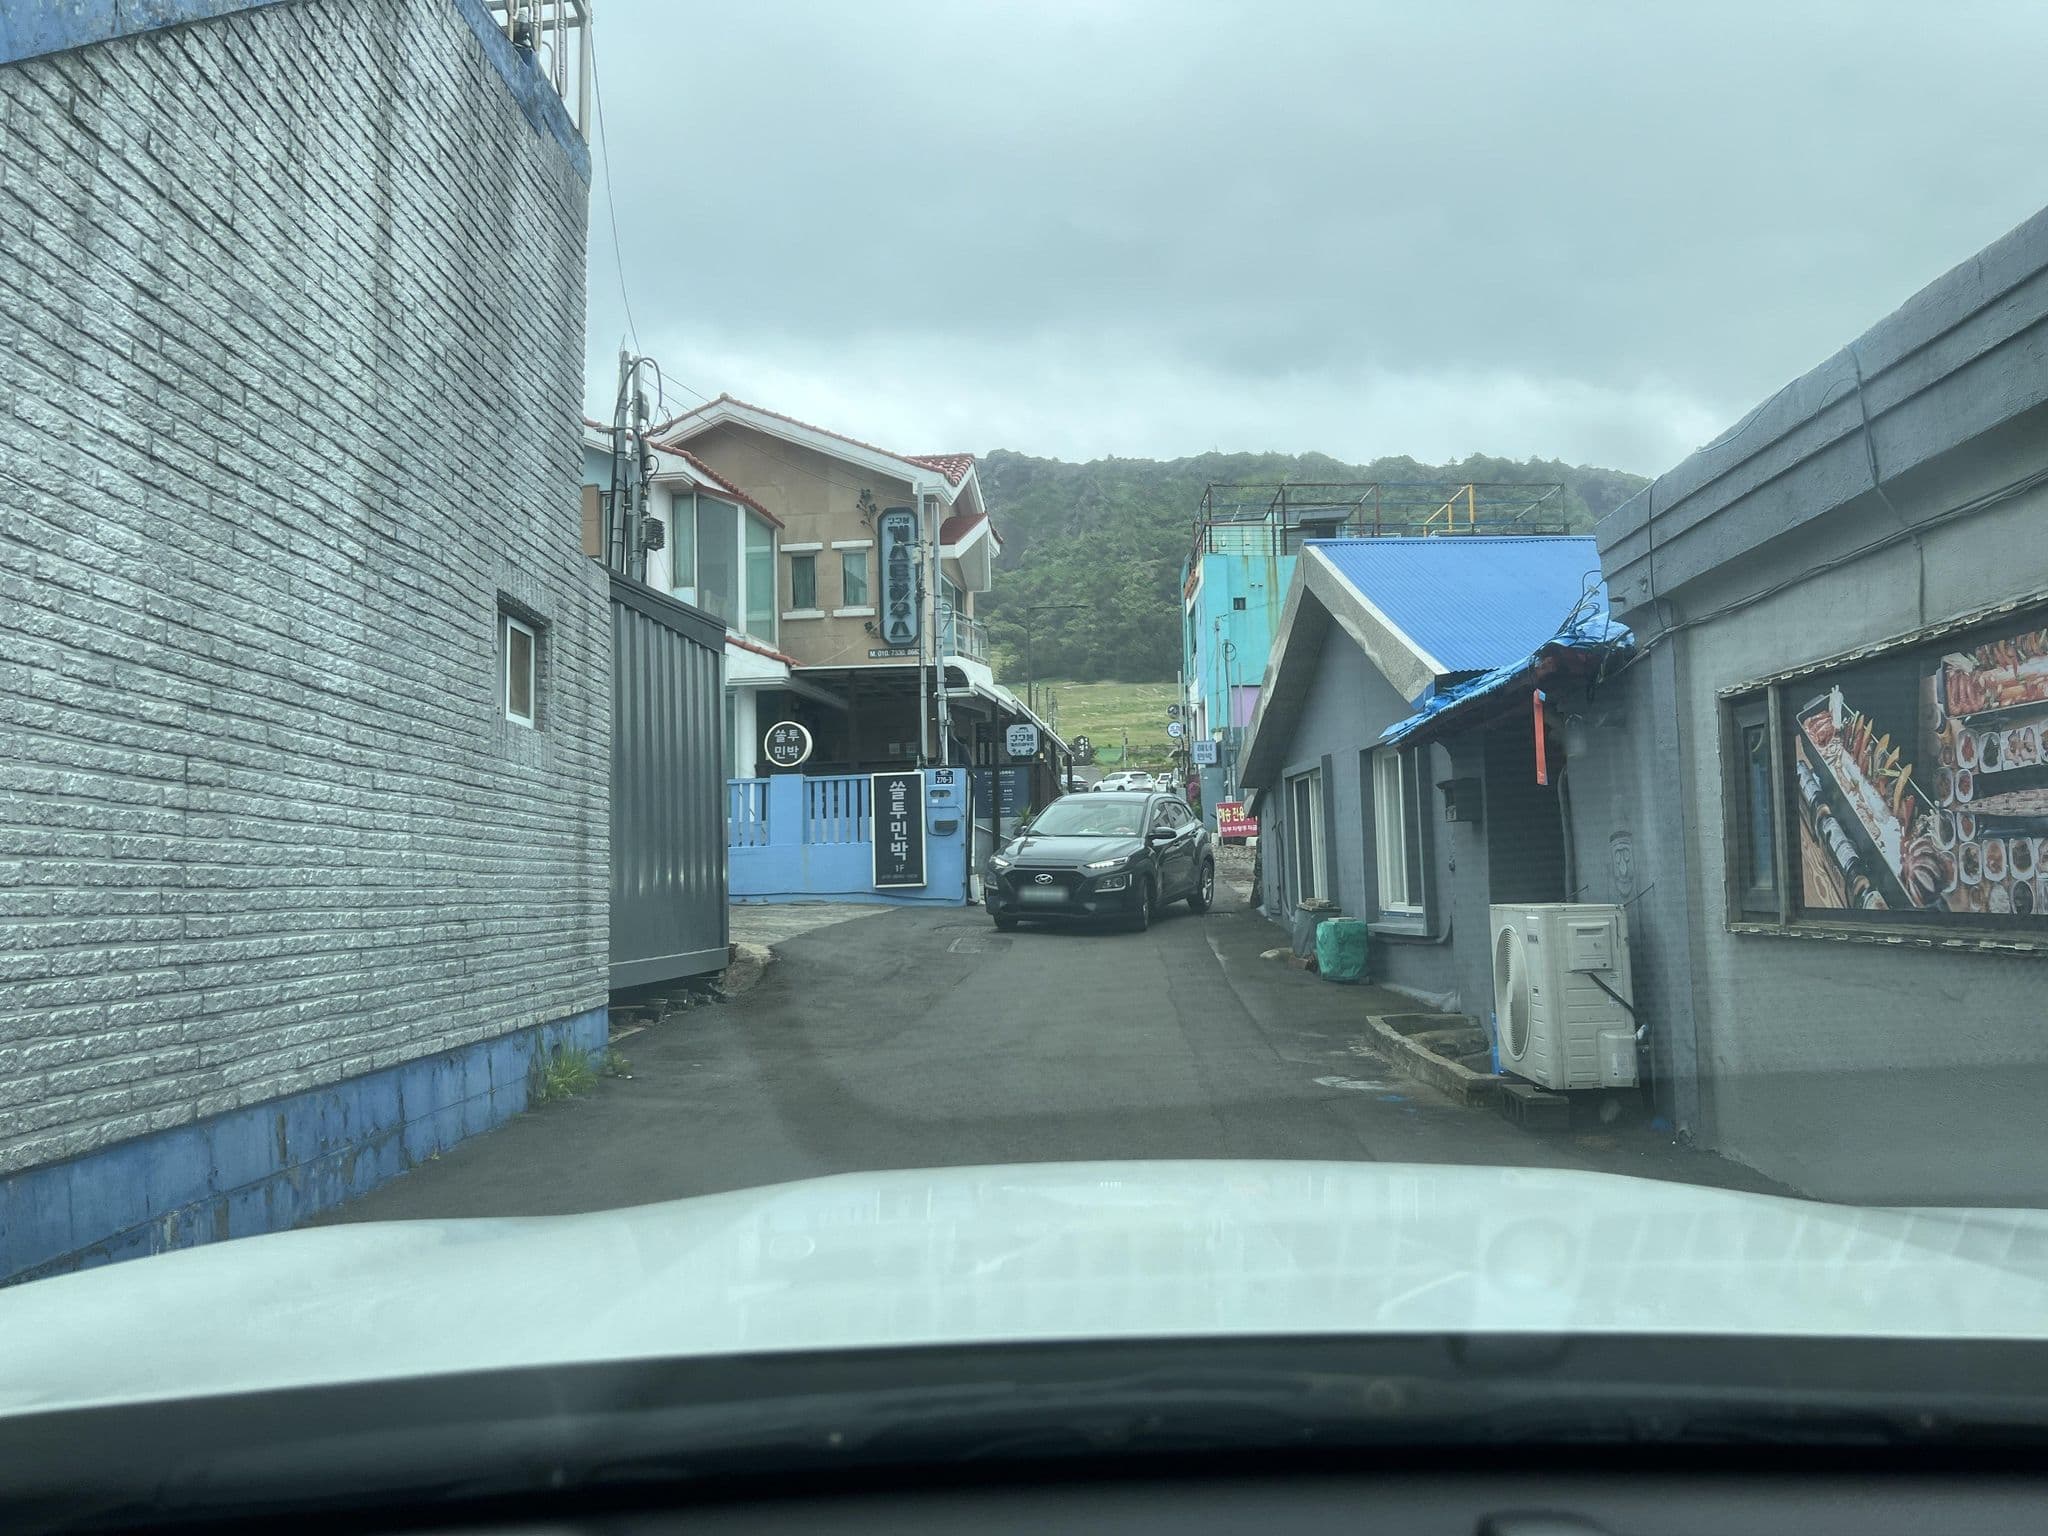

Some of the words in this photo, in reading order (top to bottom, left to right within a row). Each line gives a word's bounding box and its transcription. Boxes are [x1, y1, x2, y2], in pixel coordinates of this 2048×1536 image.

[775, 730, 800, 743] 쏠투
[775, 746, 799, 759] 민박
[889, 781, 908, 861] 쏠투민박
[1232, 806, 1245, 822] 전용
